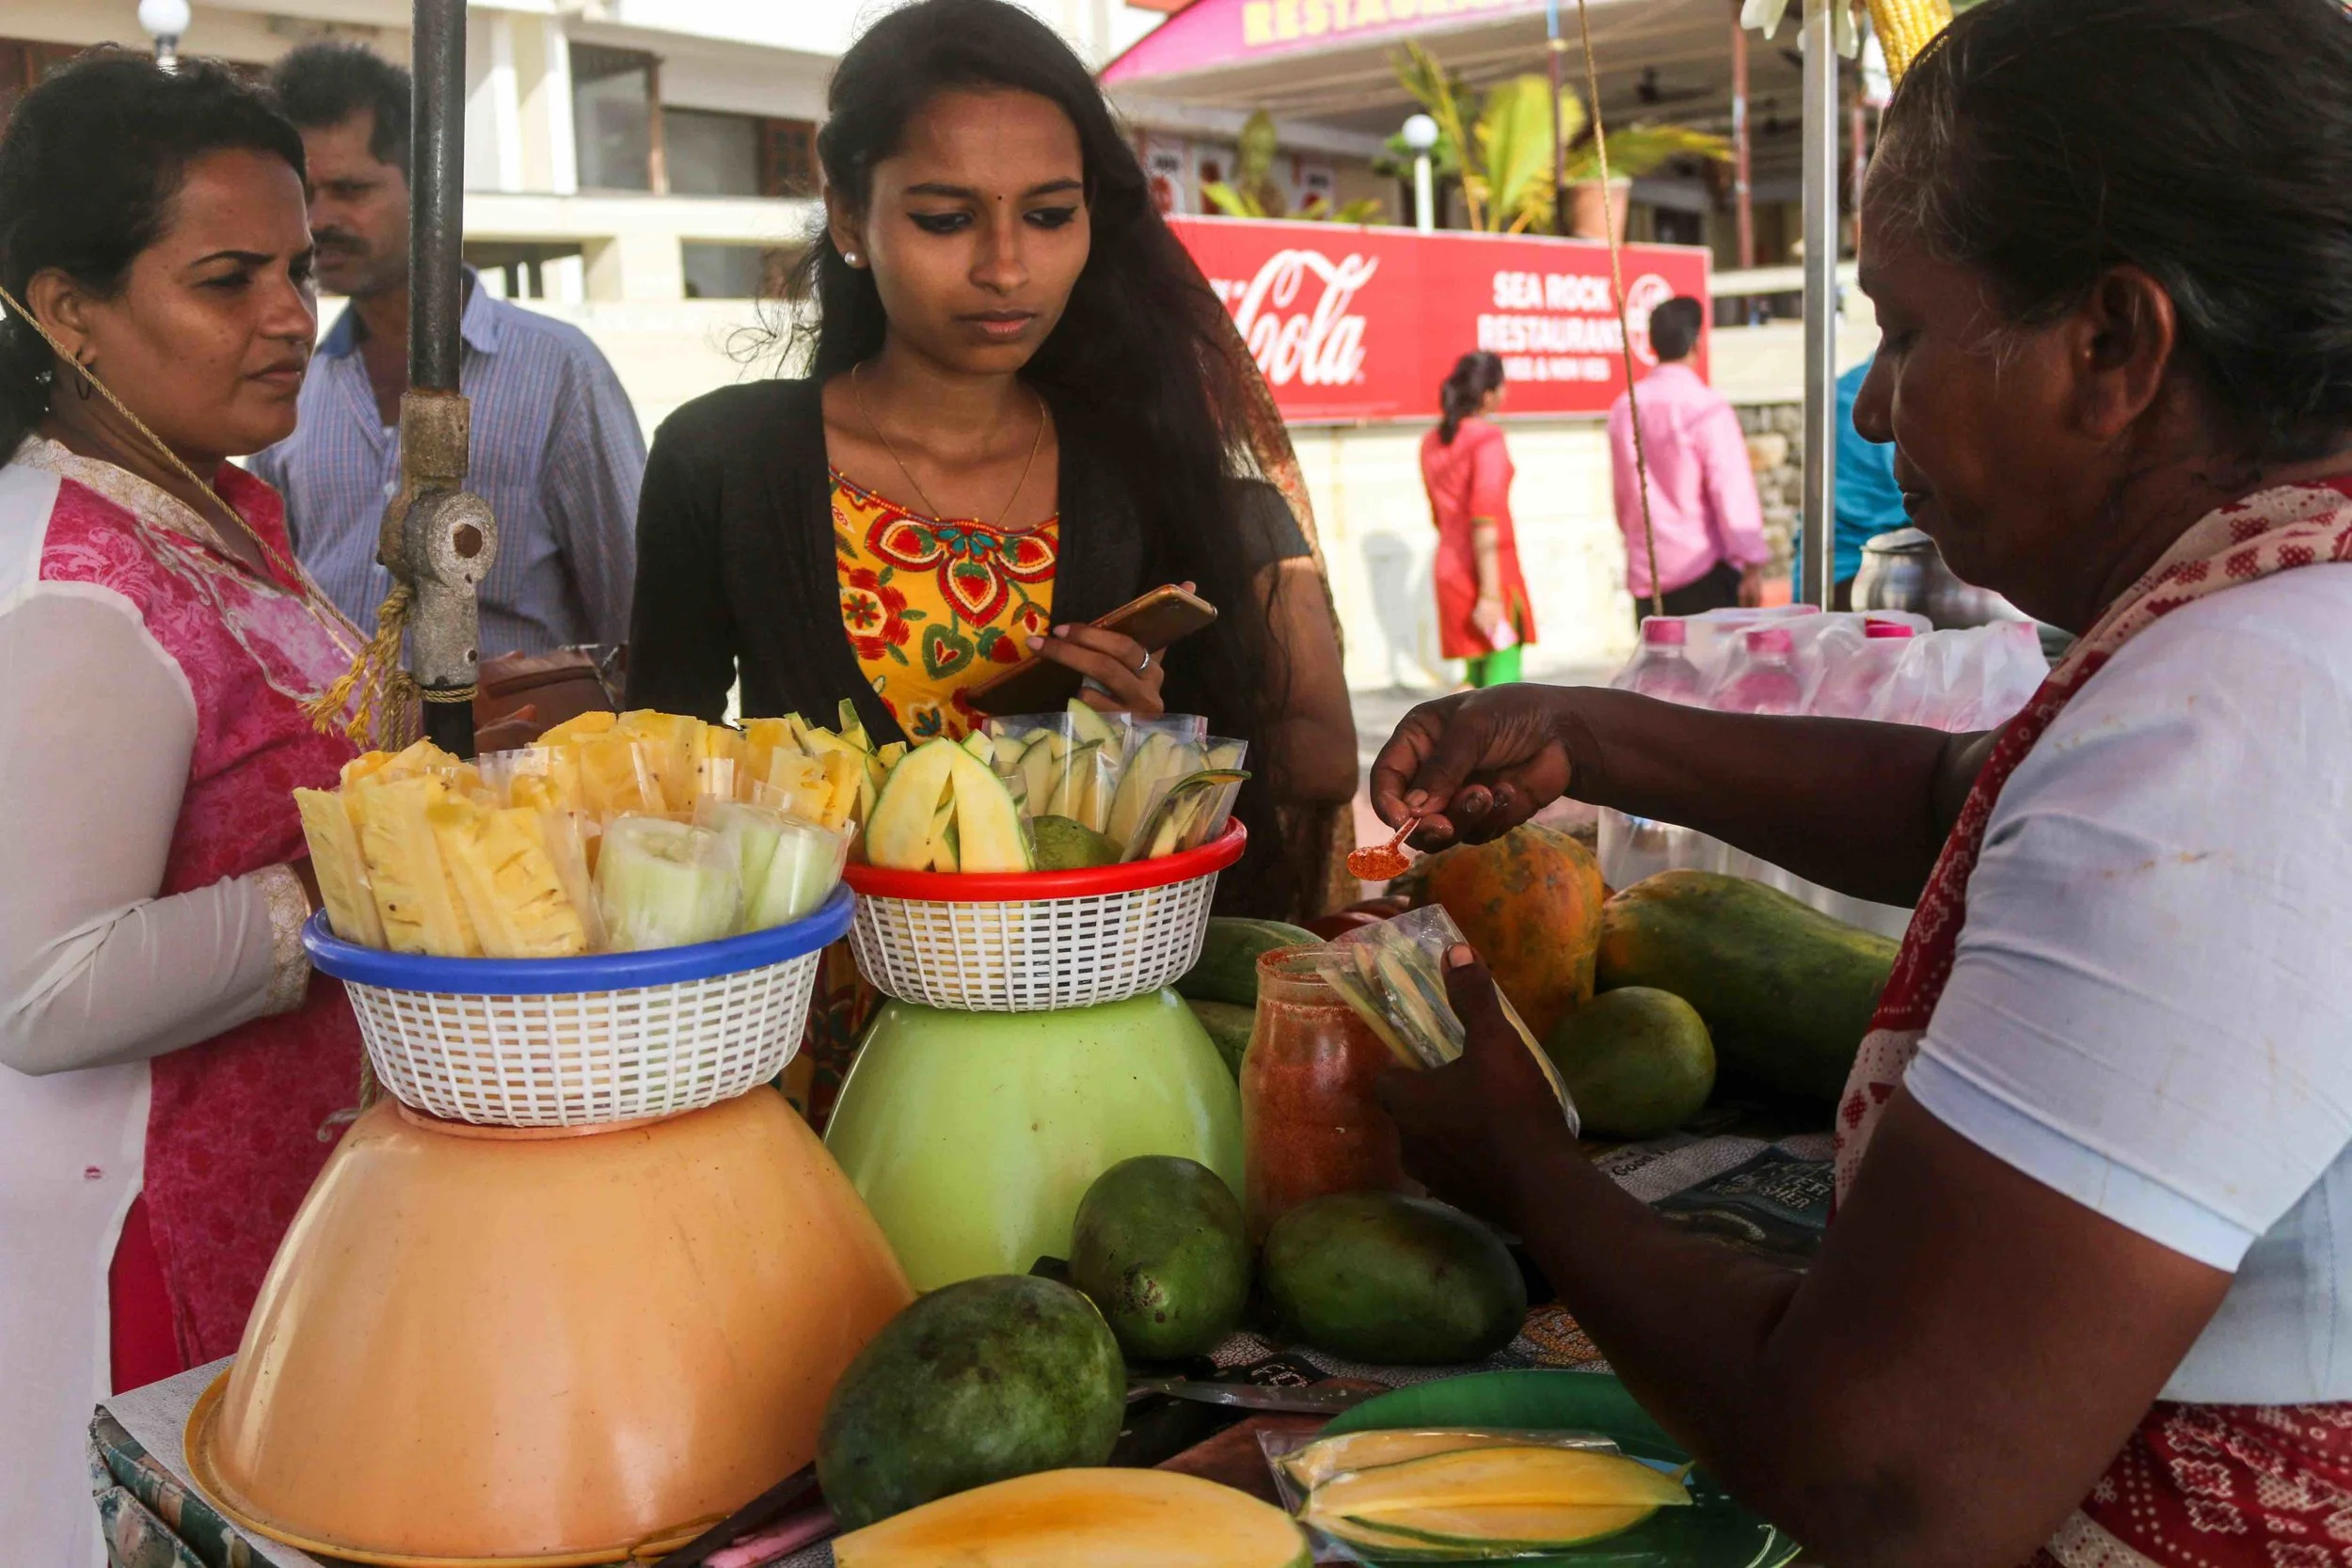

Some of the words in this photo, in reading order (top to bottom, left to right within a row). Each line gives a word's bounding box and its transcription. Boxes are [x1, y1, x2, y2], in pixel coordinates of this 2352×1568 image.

[1243, 0, 1511, 46] RESTA
[1493, 270, 1544, 309] SEA
[1545, 273, 1613, 312] ROCK
